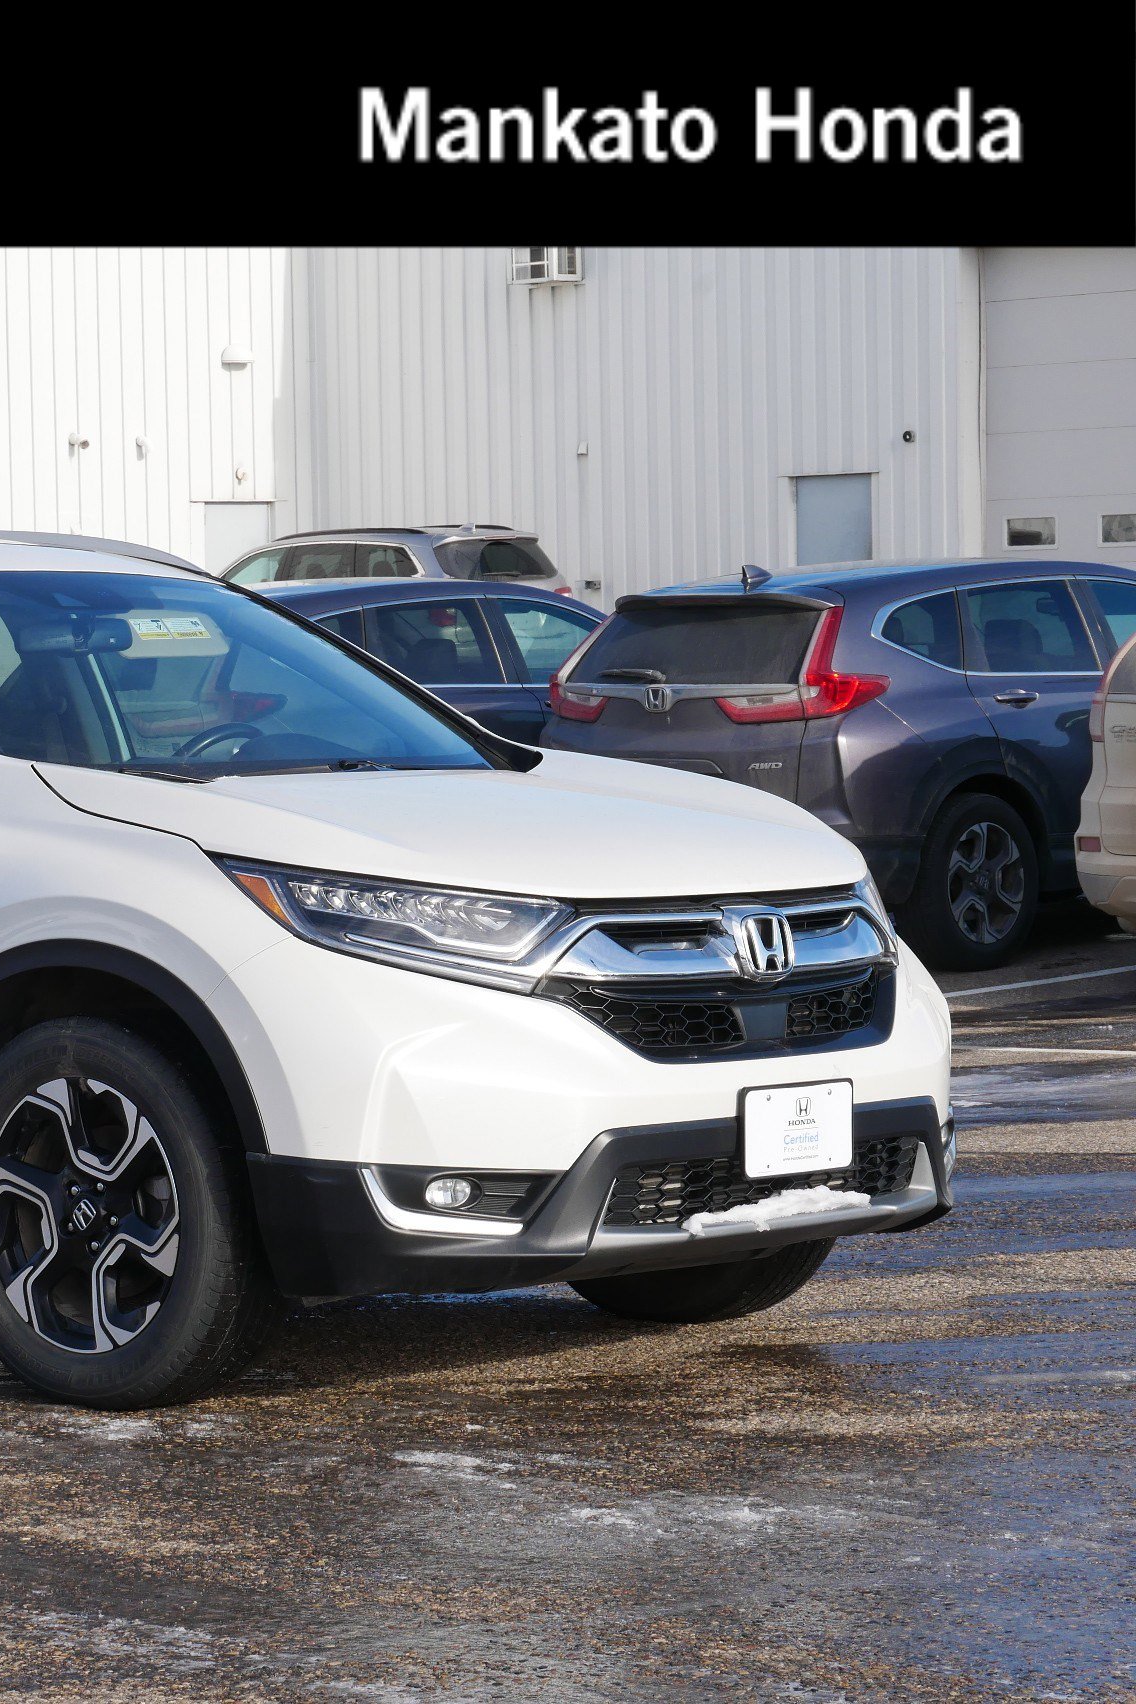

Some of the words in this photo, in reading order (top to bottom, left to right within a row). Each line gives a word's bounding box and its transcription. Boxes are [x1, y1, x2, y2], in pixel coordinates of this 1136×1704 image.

[748, 761, 783, 771] AWD
[787, 1118, 816, 1127] HONDA
[783, 1131, 819, 1145] Certified
